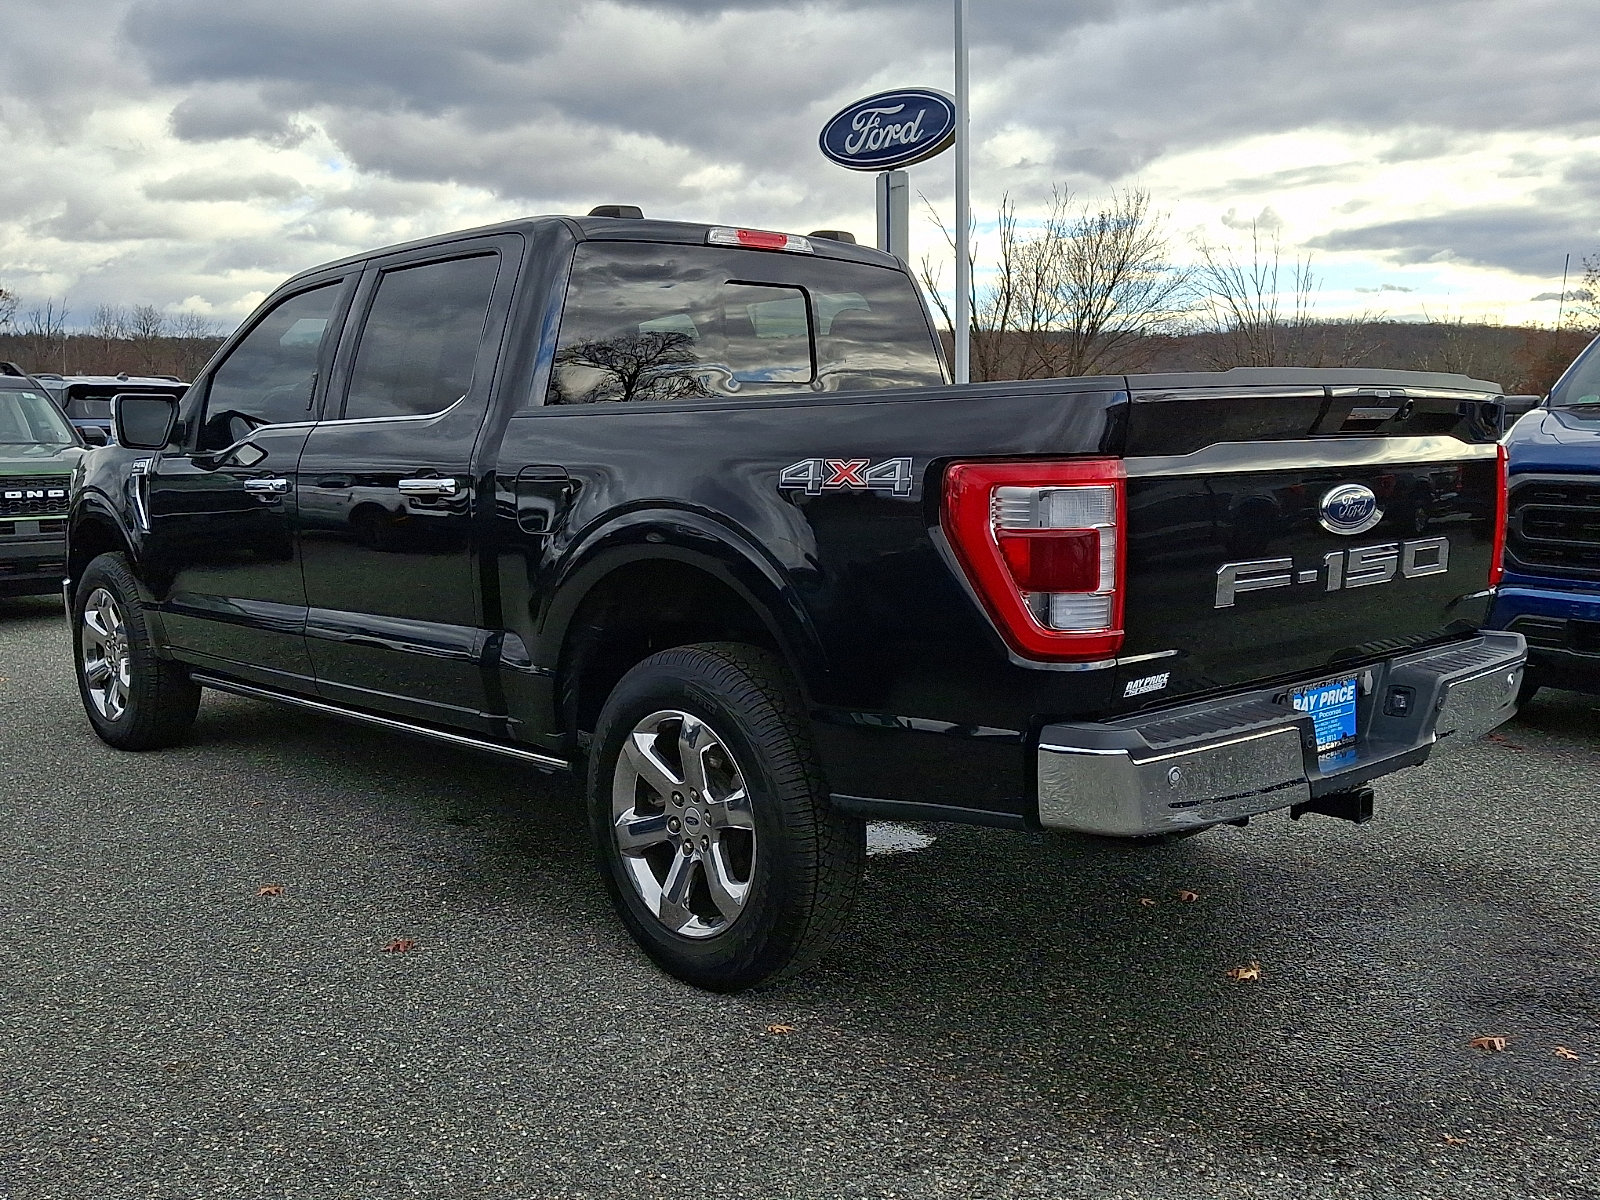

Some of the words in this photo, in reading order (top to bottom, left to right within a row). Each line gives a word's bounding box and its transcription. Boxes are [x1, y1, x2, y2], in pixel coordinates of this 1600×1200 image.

[845, 103, 926, 155] Ford
[5, 489, 71, 499] ONC
[1338, 494, 1368, 519] Ford
[1214, 536, 1449, 609] F-150
[1125, 678, 1145, 691] RAY
[1144, 671, 1171, 687] PRICE
[1318, 684, 1356, 708] PRICE
